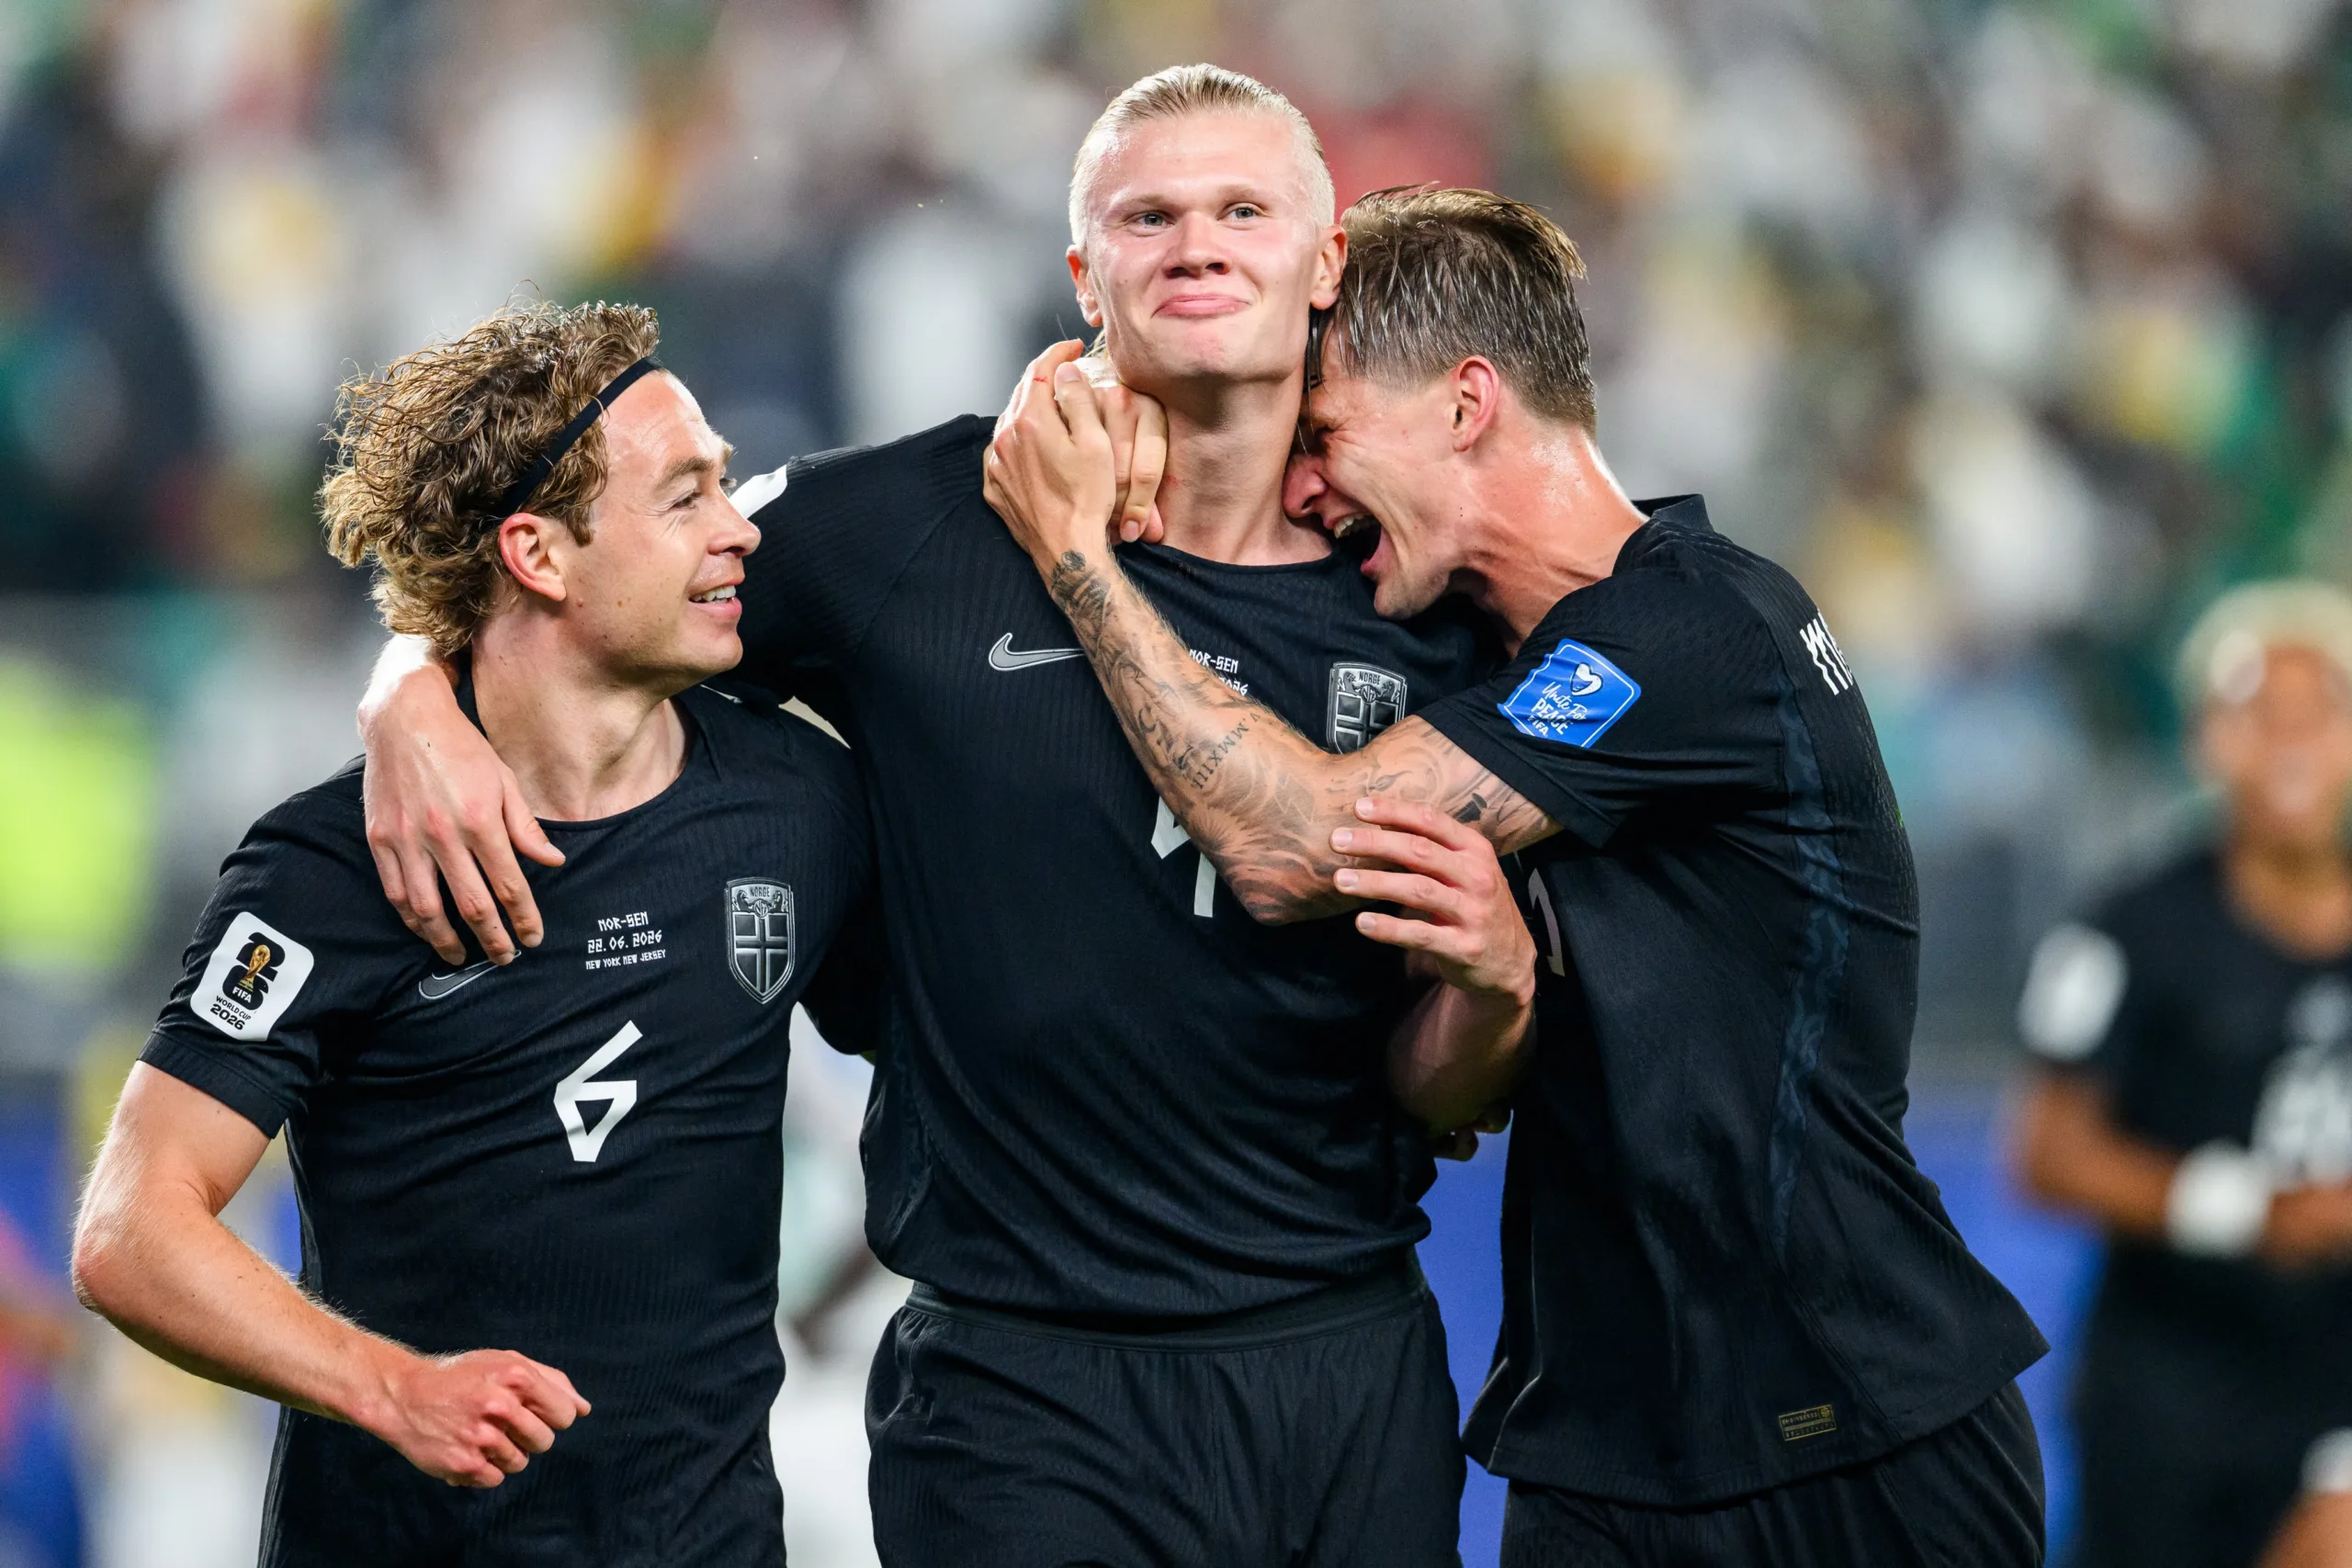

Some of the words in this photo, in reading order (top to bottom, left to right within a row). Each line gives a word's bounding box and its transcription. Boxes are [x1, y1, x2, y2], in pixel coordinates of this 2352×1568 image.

[1189, 649, 1238, 674] NOR-SEN
[1358, 671, 1381, 685] NORGE
[1542, 681, 1571, 710] Unite
[1527, 714, 1550, 737] FIFA
[1531, 697, 1573, 735] PEACE
[750, 886, 771, 897] NORGE
[597, 911, 649, 931] NOR-SEN
[585, 959, 601, 970] NEW
[602, 956, 621, 967] YORK
[622, 953, 638, 965] NEW
[639, 949, 666, 962] JERSEY
[232, 986, 253, 1003] FIFA
[209, 1003, 245, 1031] 2026
[215, 995, 240, 1014] WORLD
[238, 1010, 252, 1021] CUP
[553, 1020, 643, 1162] 6
